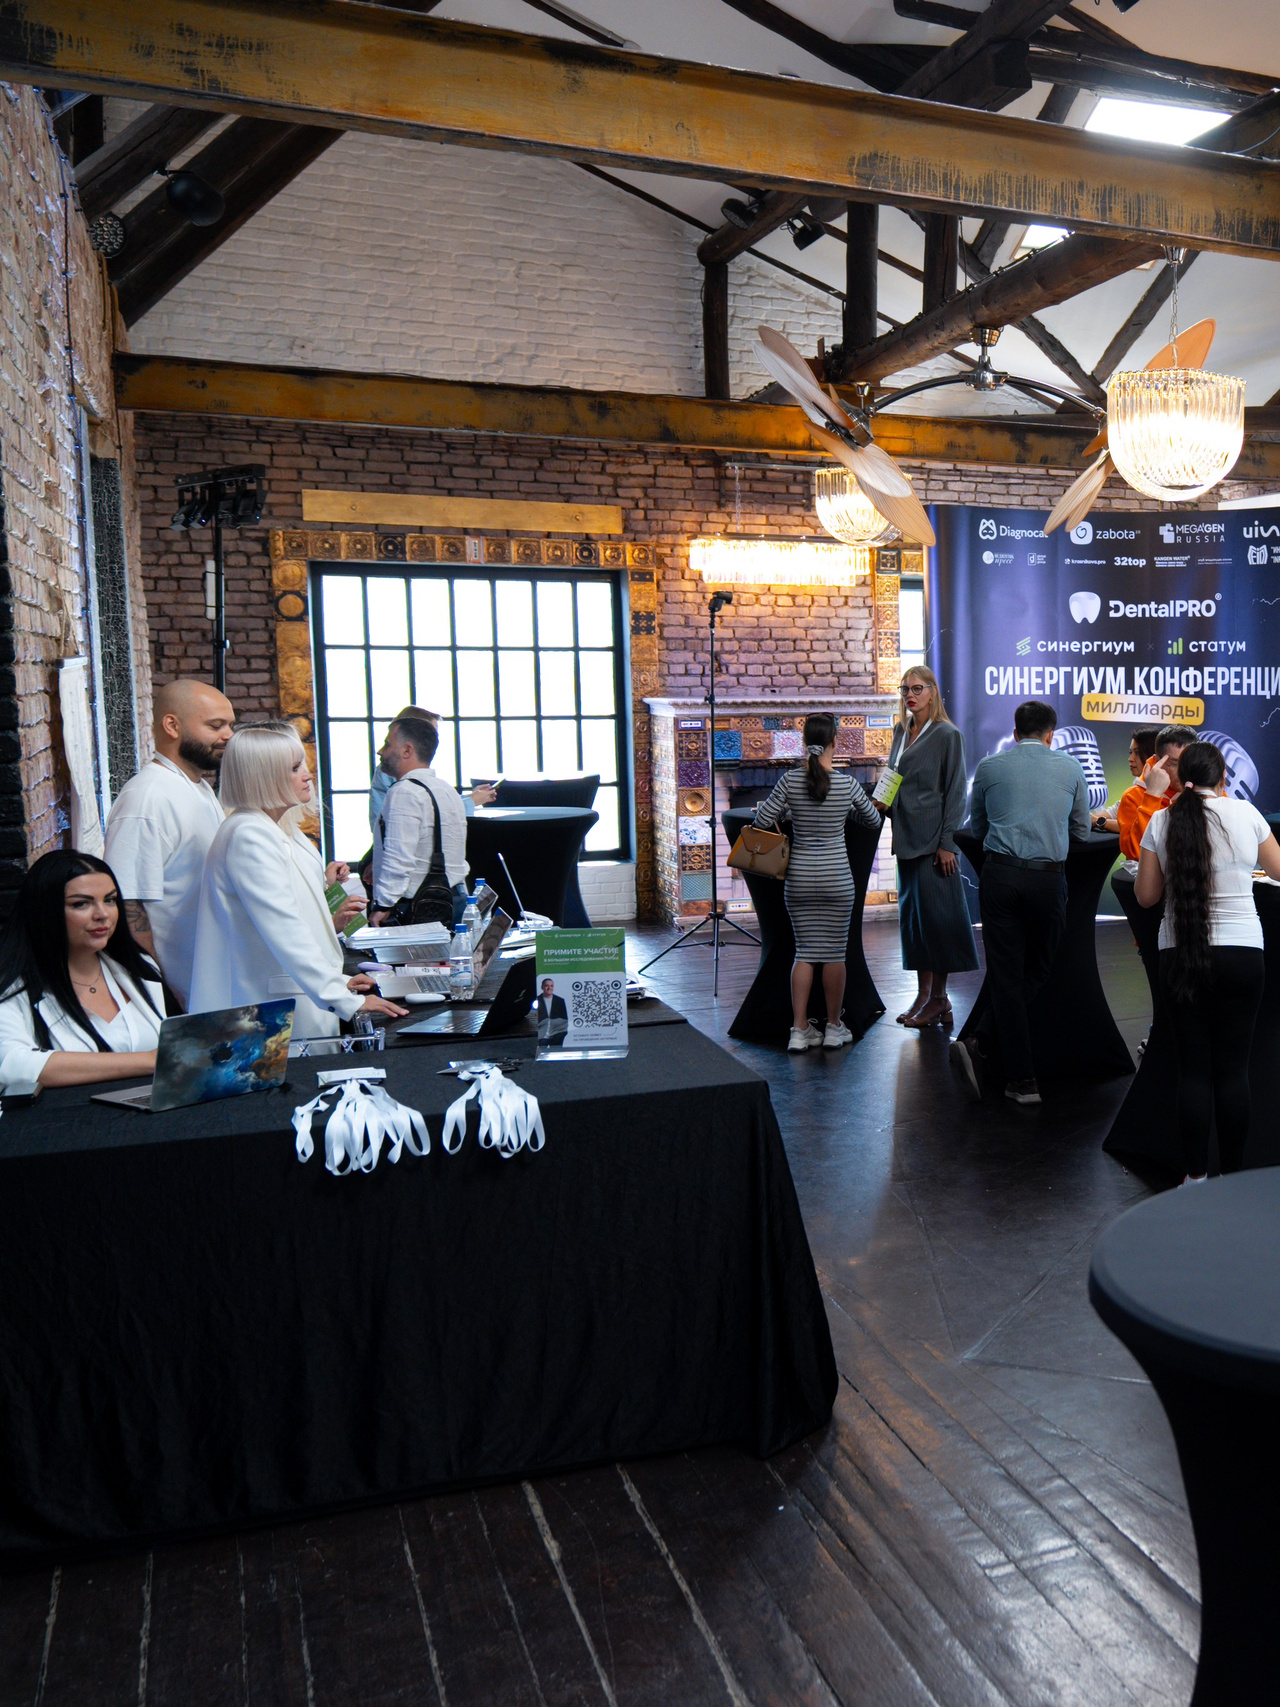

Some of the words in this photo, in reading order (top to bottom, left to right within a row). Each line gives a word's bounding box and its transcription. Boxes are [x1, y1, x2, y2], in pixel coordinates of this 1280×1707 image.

[1096, 528, 1135, 539] zabota
[1176, 535, 1225, 543] RUSSIA
[1114, 557, 1146, 567] 32top
[1037, 640, 1135, 655] синергиум
[1189, 640, 1246, 655] статум
[1086, 700, 1200, 719] миллиарды
[544, 948, 582, 956] ПРИМИТЕ
[583, 947, 619, 955] УЧАСТИЕ
